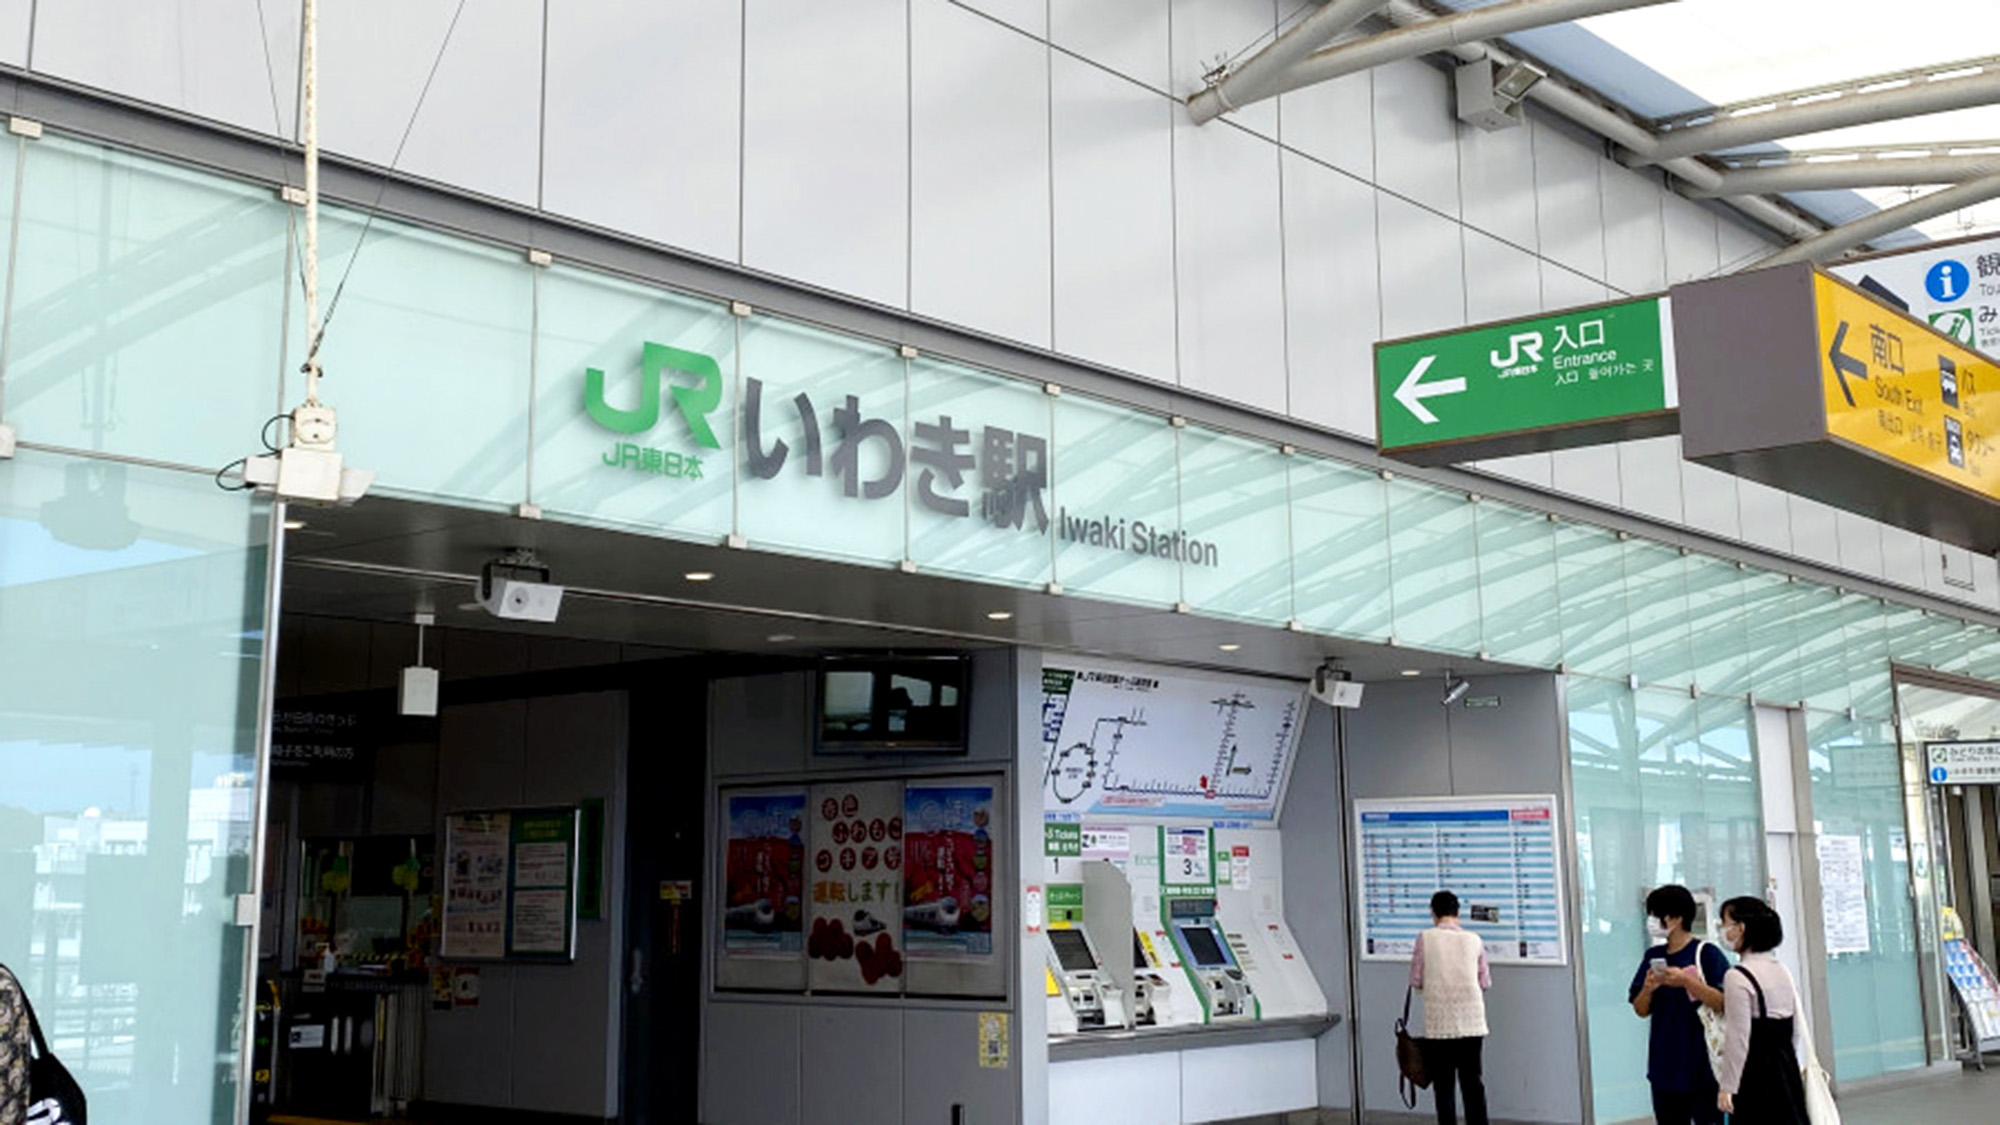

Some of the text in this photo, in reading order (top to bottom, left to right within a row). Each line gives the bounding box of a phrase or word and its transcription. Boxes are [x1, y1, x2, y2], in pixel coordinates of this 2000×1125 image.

[1490, 331, 1544, 368] JR
[1552, 319, 1605, 353] 入口
[1870, 323, 1905, 377] 南口
[1553, 350, 1617, 370] Entrance
[586, 341, 722, 450] JR
[1875, 375, 1901, 406] South
[602, 441, 704, 480] JR東日本
[744, 377, 1049, 535] いわき駅
[1060, 506, 1218, 568] Iwaki Station
[1053, 857, 1059, 875] 1
[1183, 858, 1193, 876] 3
